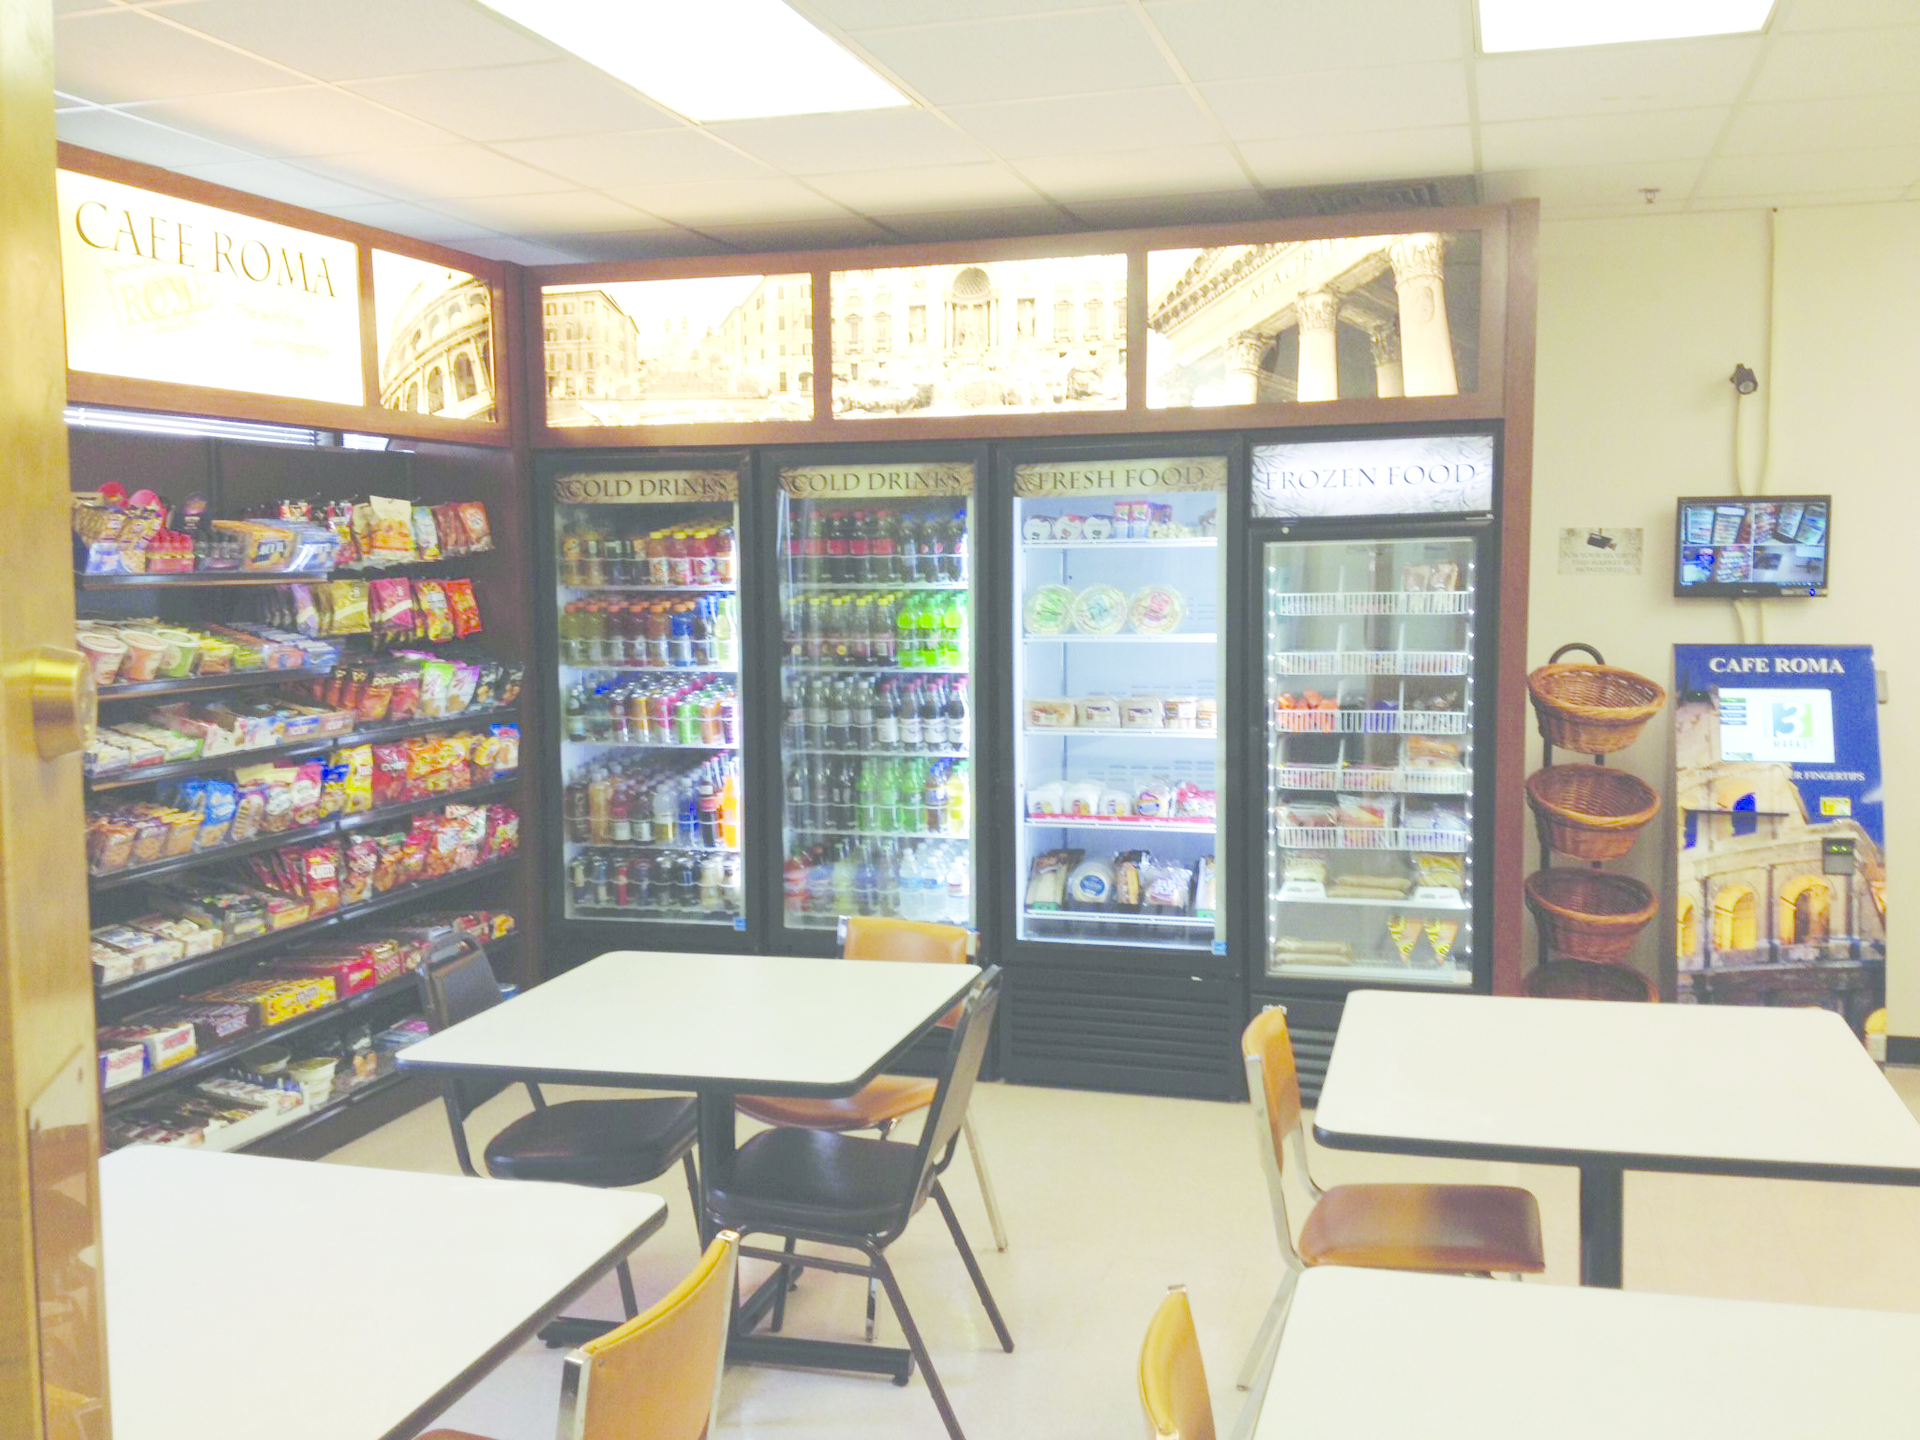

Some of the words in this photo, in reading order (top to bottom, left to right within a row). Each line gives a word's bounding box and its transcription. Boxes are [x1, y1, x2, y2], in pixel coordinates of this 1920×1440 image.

[75, 201, 197, 268] CAFE
[213, 231, 338, 298] ROMA
[567, 478, 633, 498] COLD
[638, 477, 728, 498] DRINKS
[791, 472, 861, 493] COLD
[867, 471, 962, 492] DRINKS
[1038, 469, 1116, 491] FRESH
[1125, 466, 1206, 489] FOOD
[1265, 467, 1377, 491] FROZEN
[1387, 463, 1476, 486] FOOD
[1709, 657, 1770, 673] CAFE
[1774, 657, 1846, 673] ROMA
[1773, 739, 1815, 749] MARKET
[1805, 770, 1866, 781] FINGERTIPS
